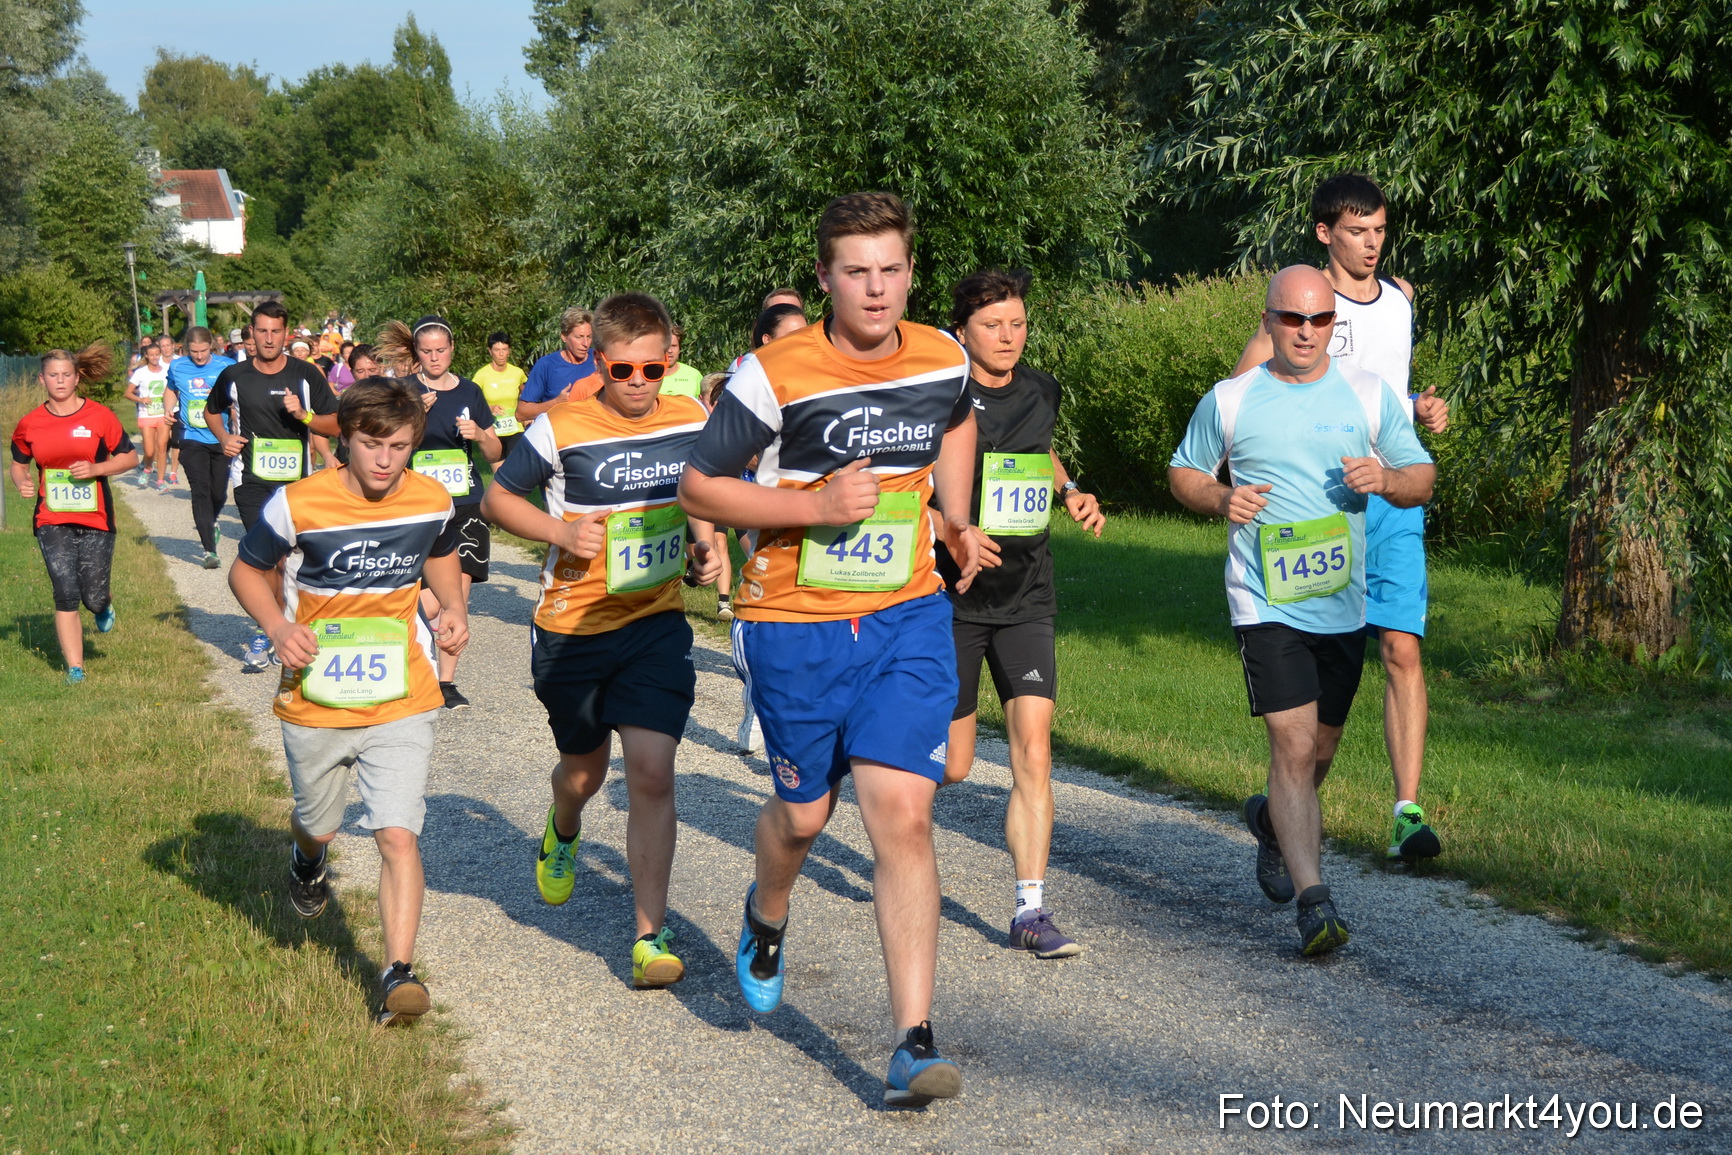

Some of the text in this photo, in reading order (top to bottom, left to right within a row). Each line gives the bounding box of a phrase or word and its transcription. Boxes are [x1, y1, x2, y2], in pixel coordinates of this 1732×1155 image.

[847, 421, 936, 448] Fischer
[857, 441, 932, 458] AUTOMOBILE
[259, 455, 297, 470] 1093
[614, 461, 686, 484] Fischer
[51, 486, 92, 500] 1168
[992, 486, 1048, 513] 1188
[618, 534, 681, 571] 1518
[826, 531, 894, 564] 443
[347, 552, 420, 571] Fischer
[830, 569, 851, 577] Lukas
[1273, 545, 1346, 582] 1435
[323, 653, 388, 682] 445
